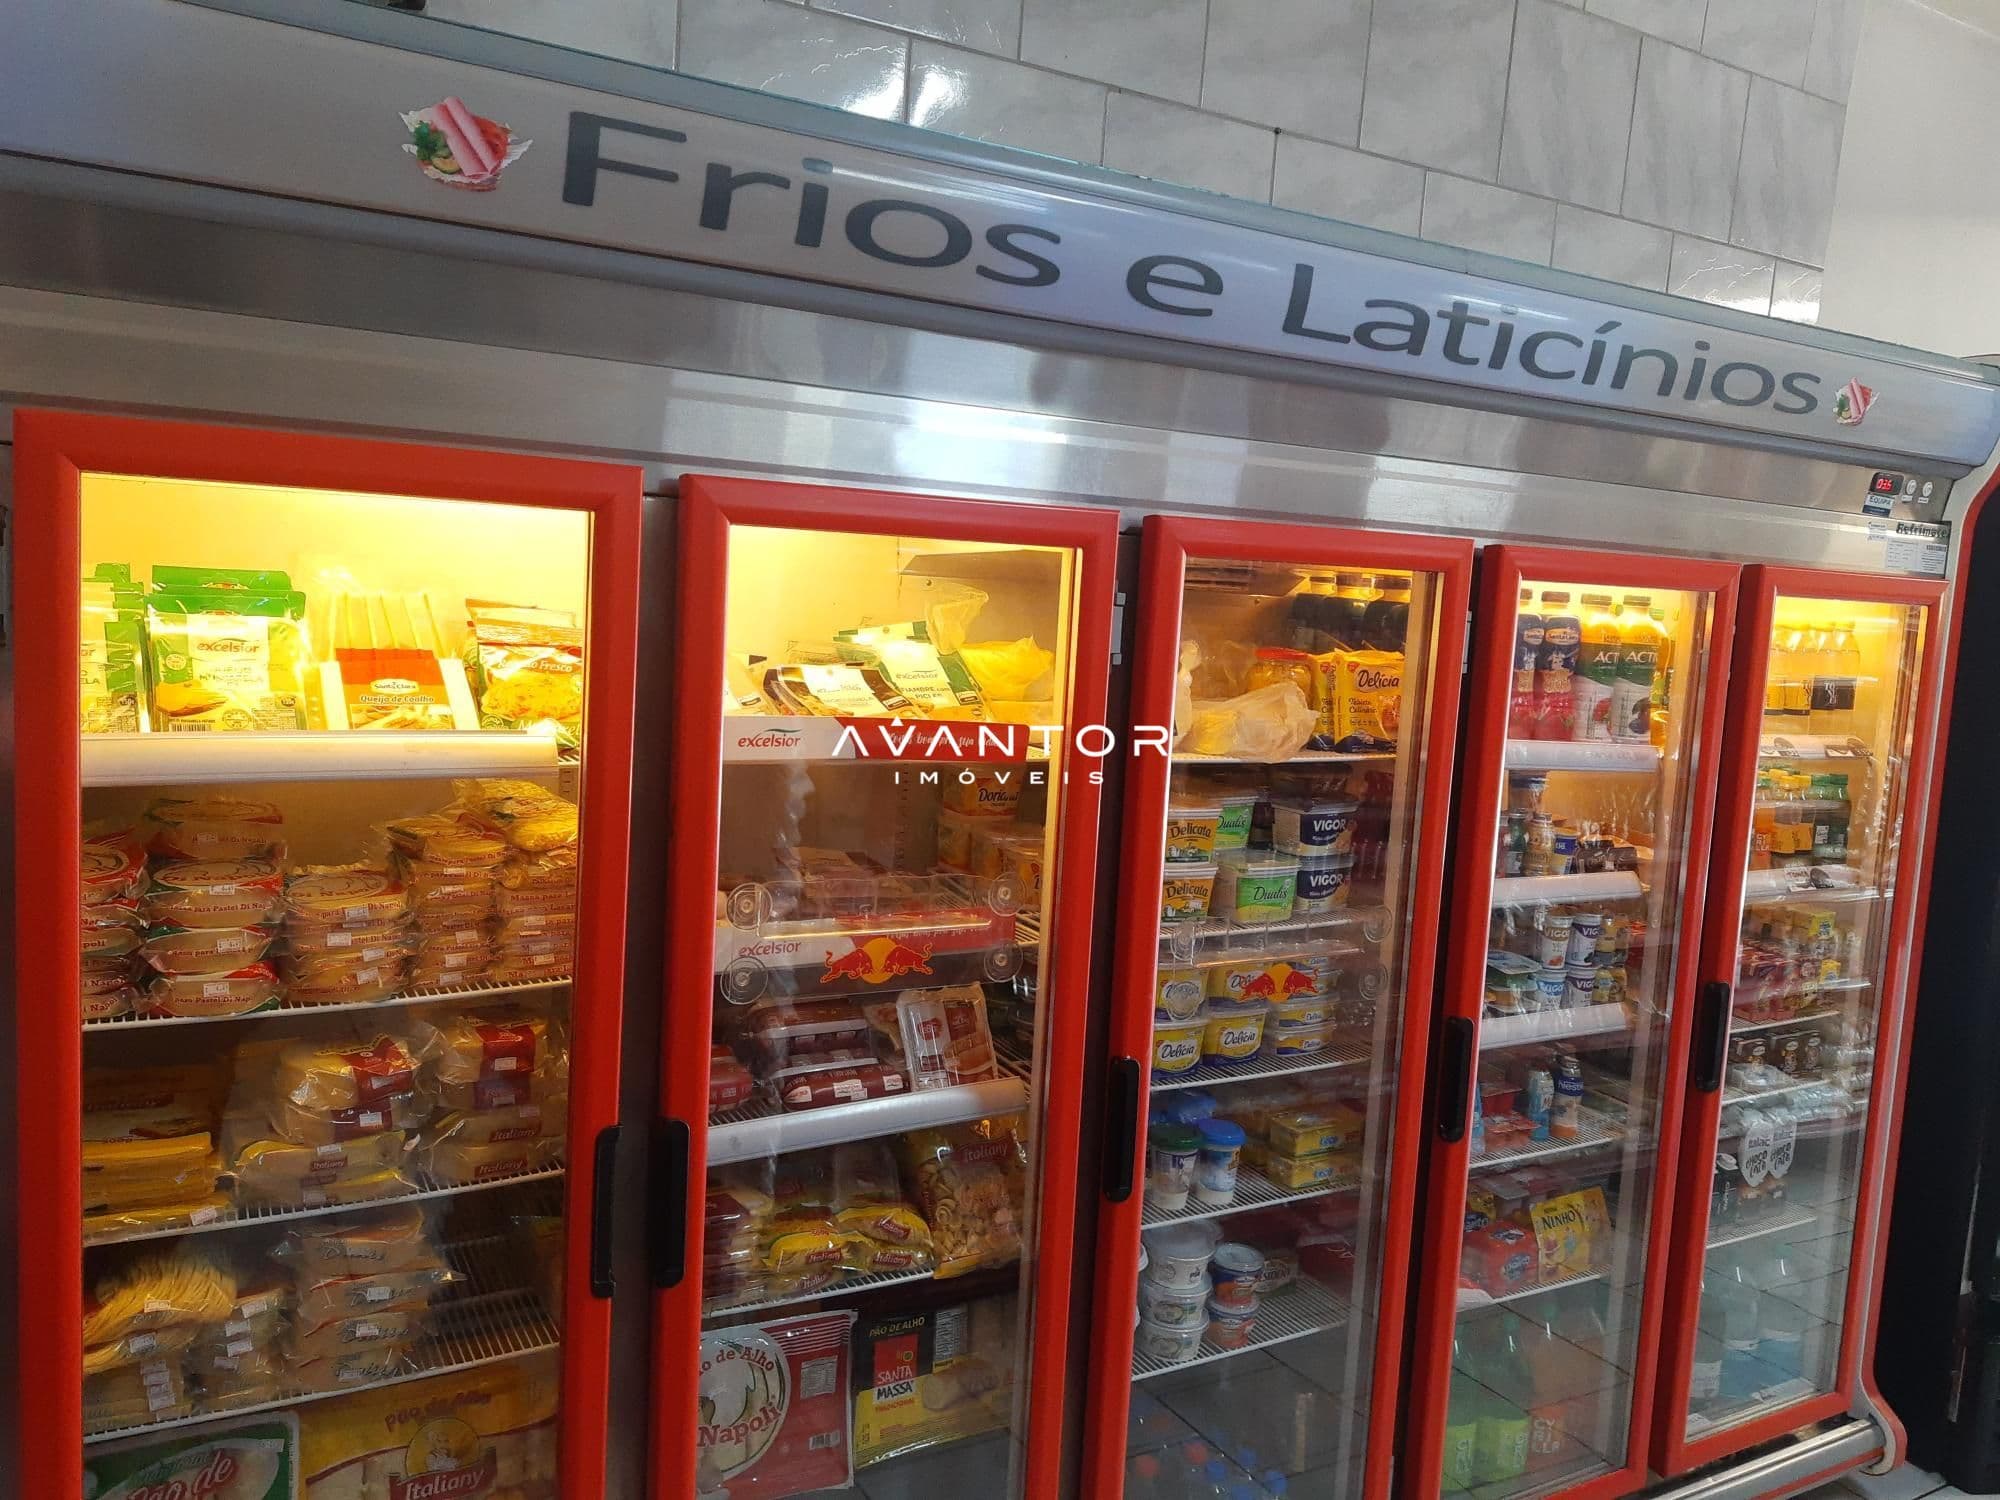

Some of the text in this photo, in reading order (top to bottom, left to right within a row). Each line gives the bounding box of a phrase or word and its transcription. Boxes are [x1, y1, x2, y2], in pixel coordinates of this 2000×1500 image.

[562, 111, 1822, 415] Frios e Laticínios
[540, 660, 573, 672] Fresco
[1357, 669, 1400, 689] Delícia
[360, 695, 389, 704] Queijo
[738, 732, 801, 748] excelsior
[1170, 822, 1212, 838] Delicata
[1313, 819, 1347, 832] VIGOR
[1310, 873, 1344, 887] VIGOR
[1166, 882, 1209, 898] Delicata
[738, 940, 802, 957] excelsior
[1223, 1030, 1256, 1045] Delícia
[1161, 1043, 1195, 1059] Delícia
[480, 1159, 522, 1174] Italiany
[1541, 1210, 1577, 1230] NINHO
[901, 1316, 926, 1329] ALHO
[716, 1349, 735, 1364] de
[877, 1365, 913, 1385] SANTA
[876, 1380, 915, 1401] MASSA
[696, 1401, 783, 1447] Napoli
[405, 1467, 485, 1500] Italiany
